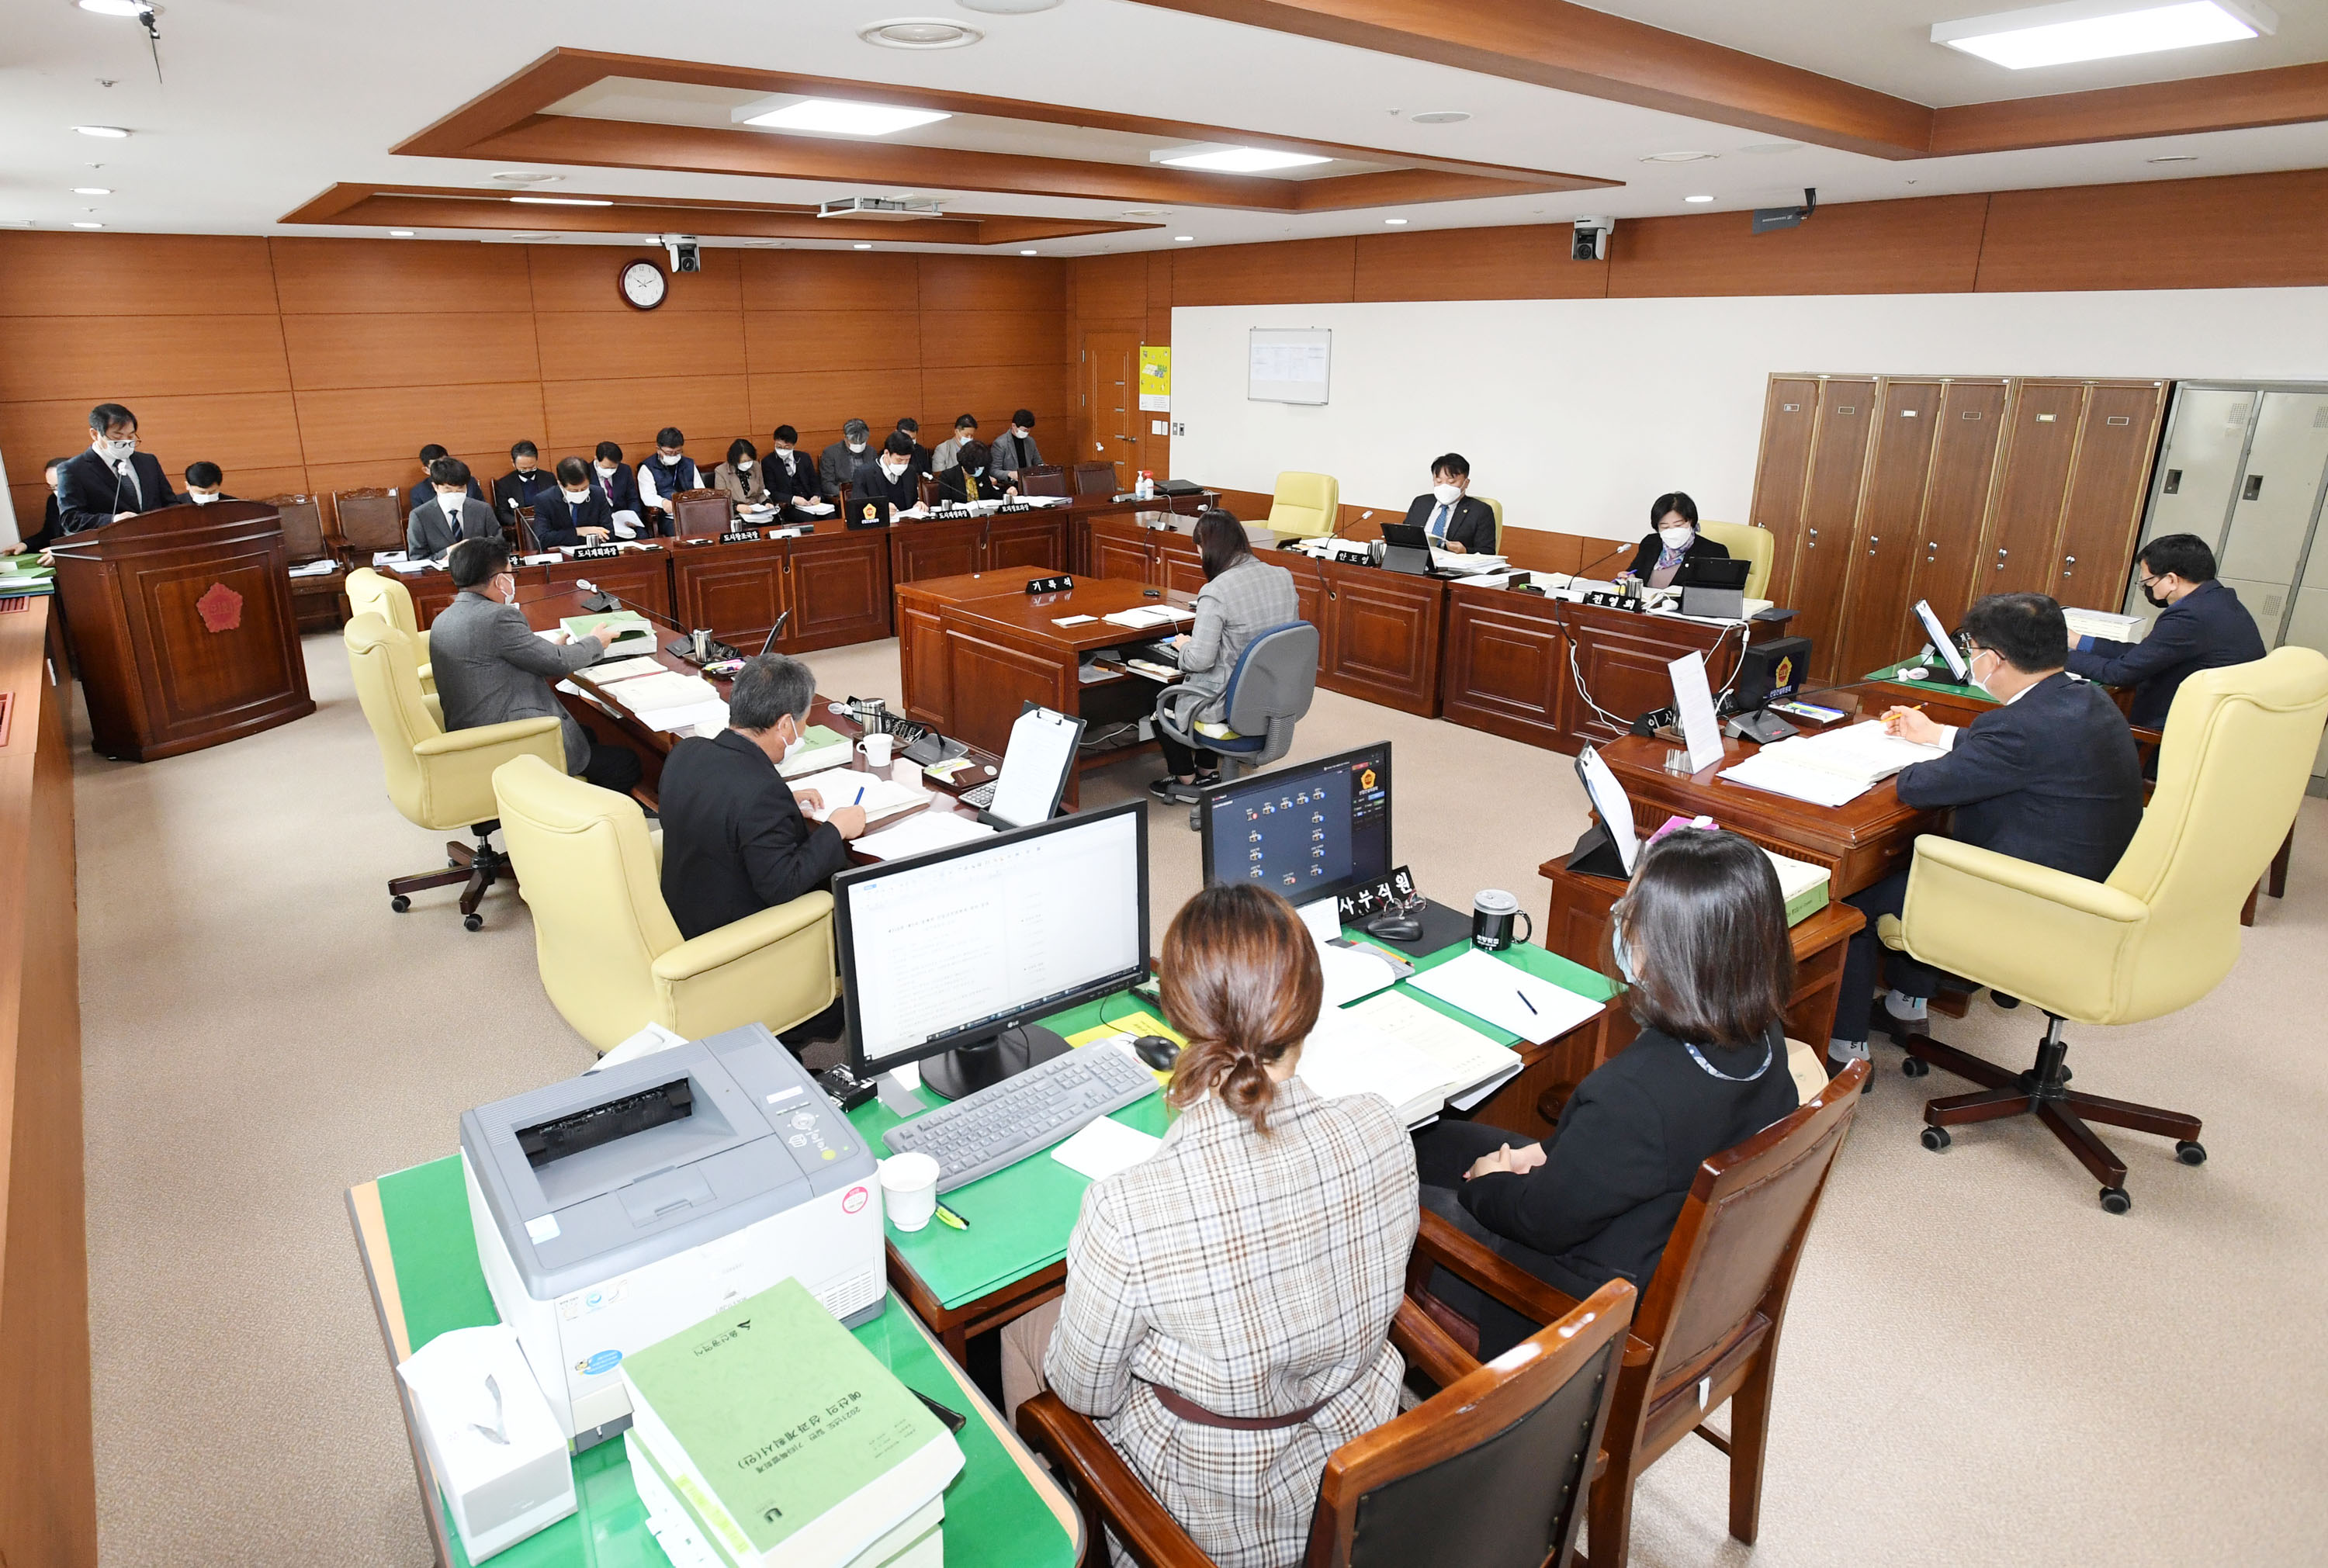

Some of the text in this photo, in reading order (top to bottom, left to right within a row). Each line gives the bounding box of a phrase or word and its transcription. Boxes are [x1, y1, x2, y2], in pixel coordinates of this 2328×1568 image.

[1339, 552, 1370, 565] 안도영
[693, 1329, 739, 1358] 울산광역시
[825, 1390, 861, 1416] 예산의
[826, 1405, 861, 1430] 2021년도
[737, 1414, 822, 1469] 성과계획서(안)
